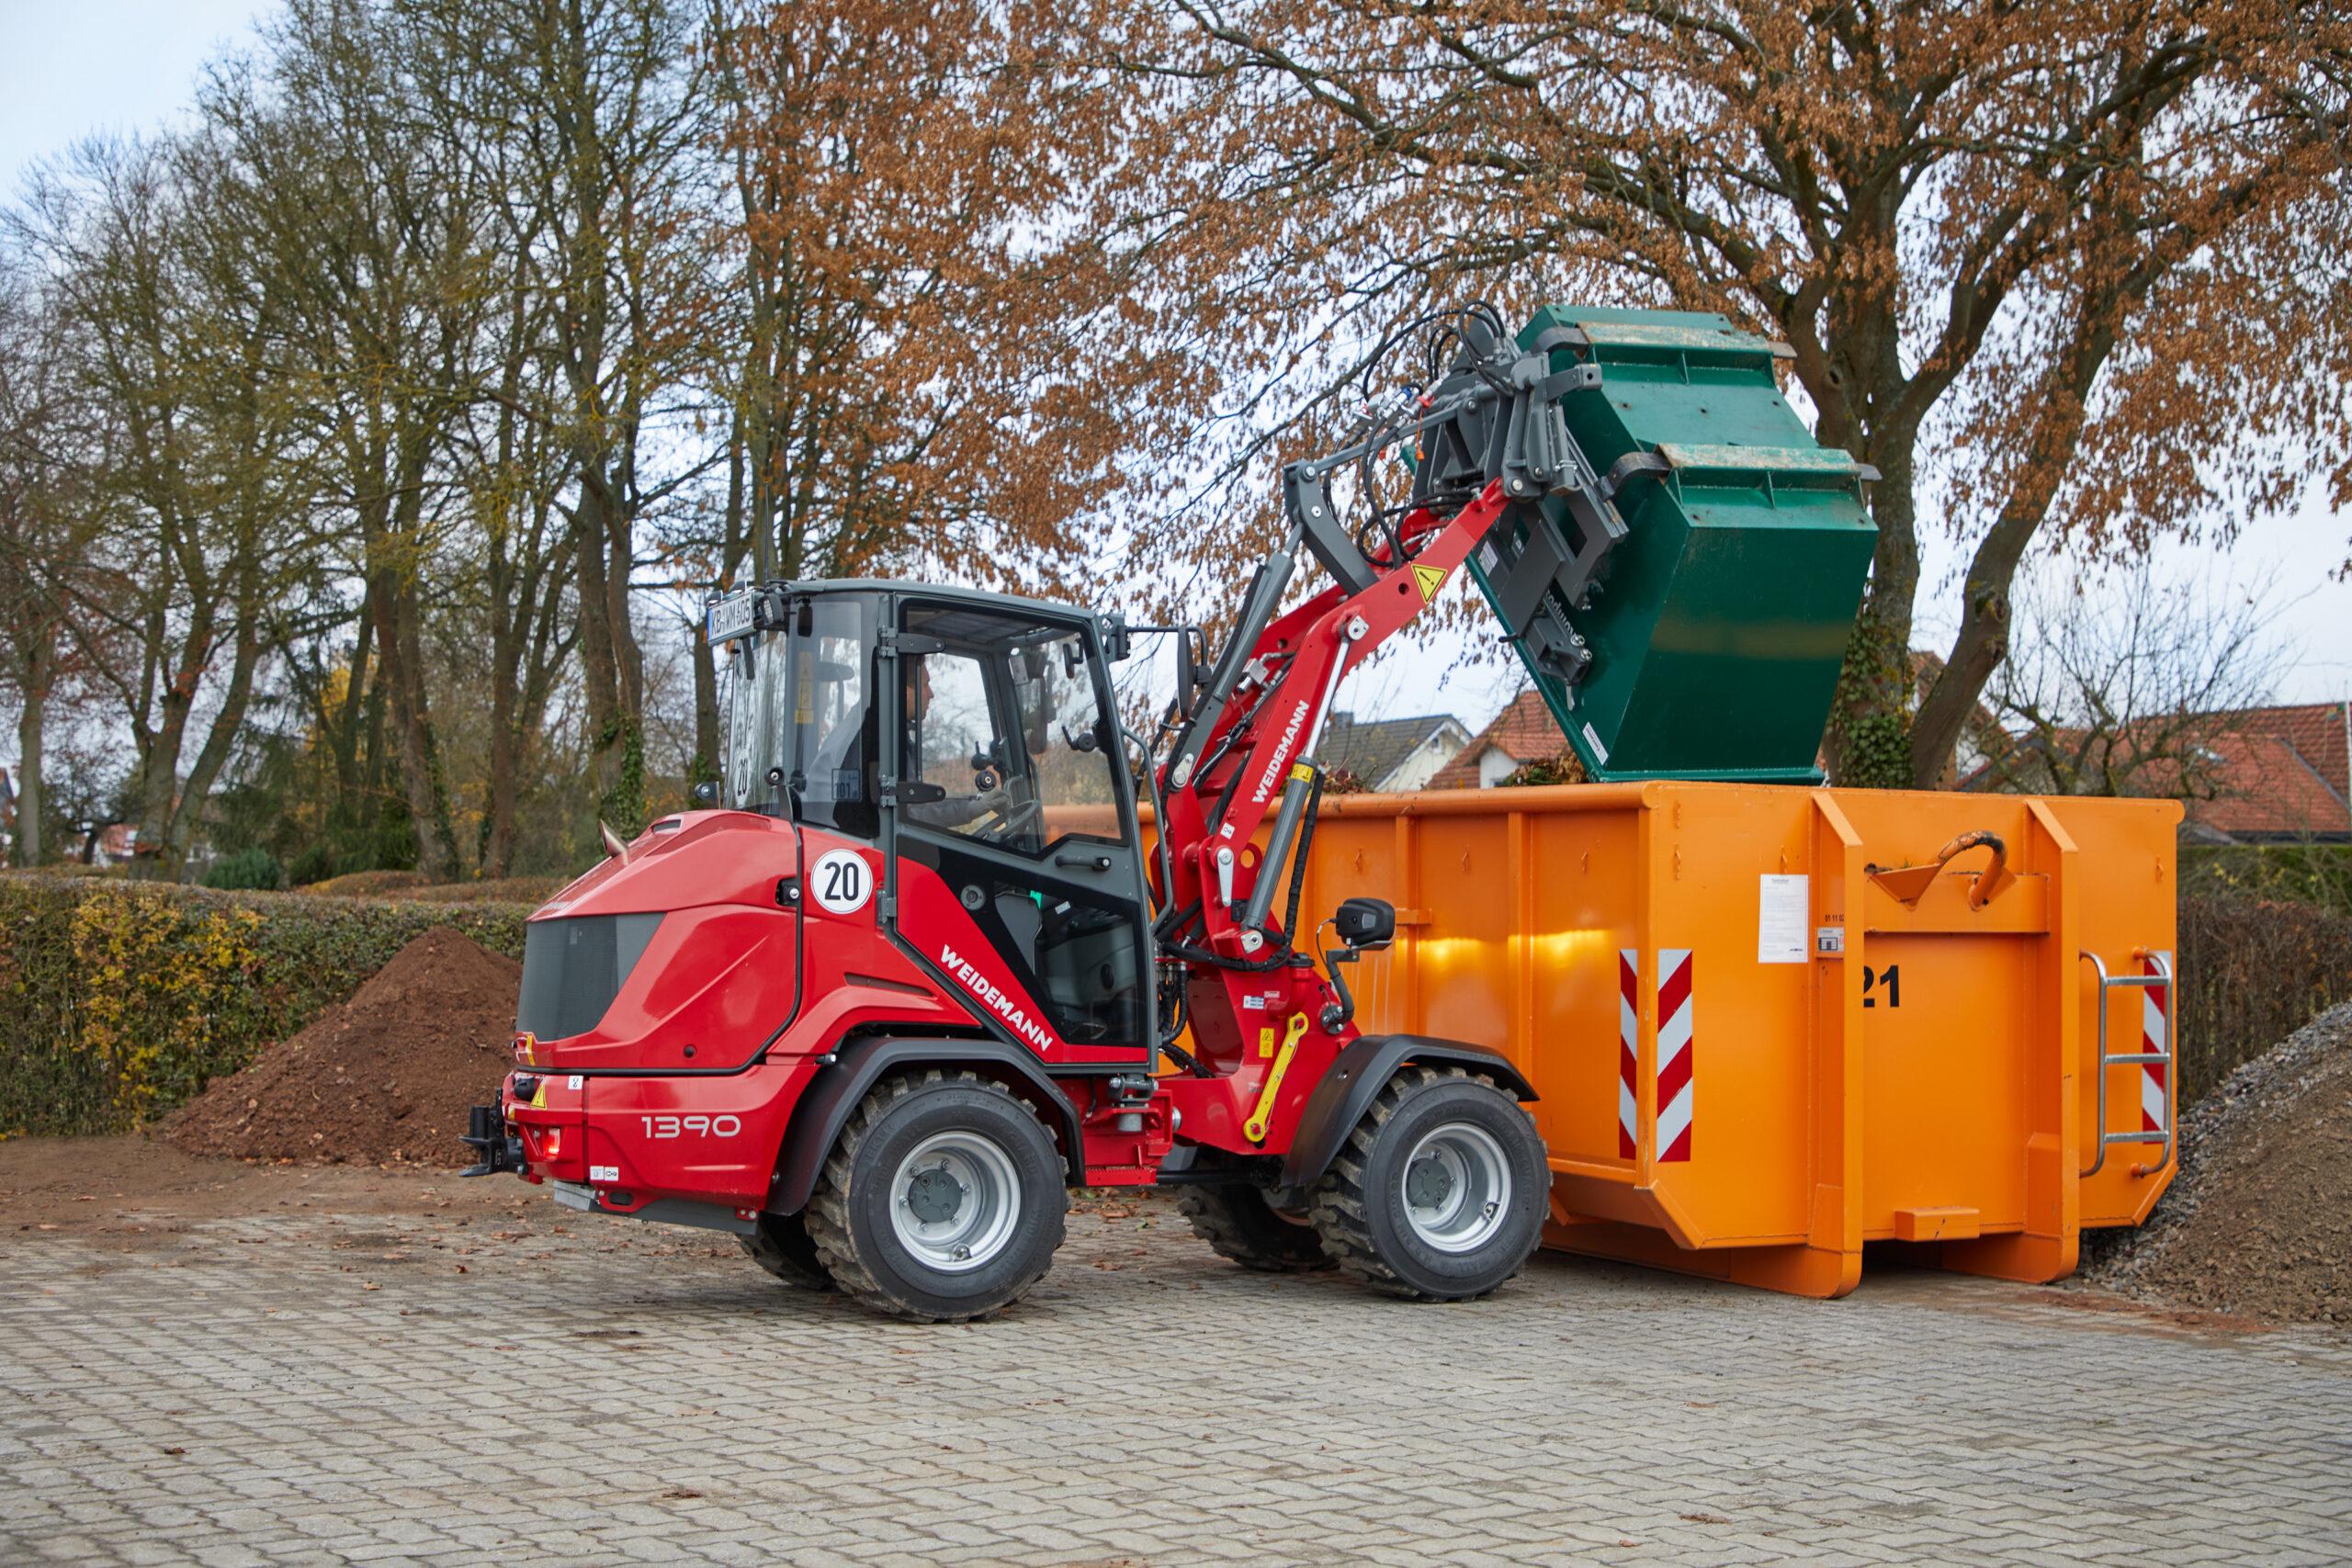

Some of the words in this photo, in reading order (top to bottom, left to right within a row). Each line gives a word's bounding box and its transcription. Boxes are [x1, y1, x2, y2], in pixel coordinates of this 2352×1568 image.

[1251, 699, 1309, 803] WEIDEMANN
[738, 757, 749, 796] 20
[824, 862, 859, 901] 20
[941, 944, 1054, 1052] WEIDEMANN
[641, 1114, 741, 1138] 1390
